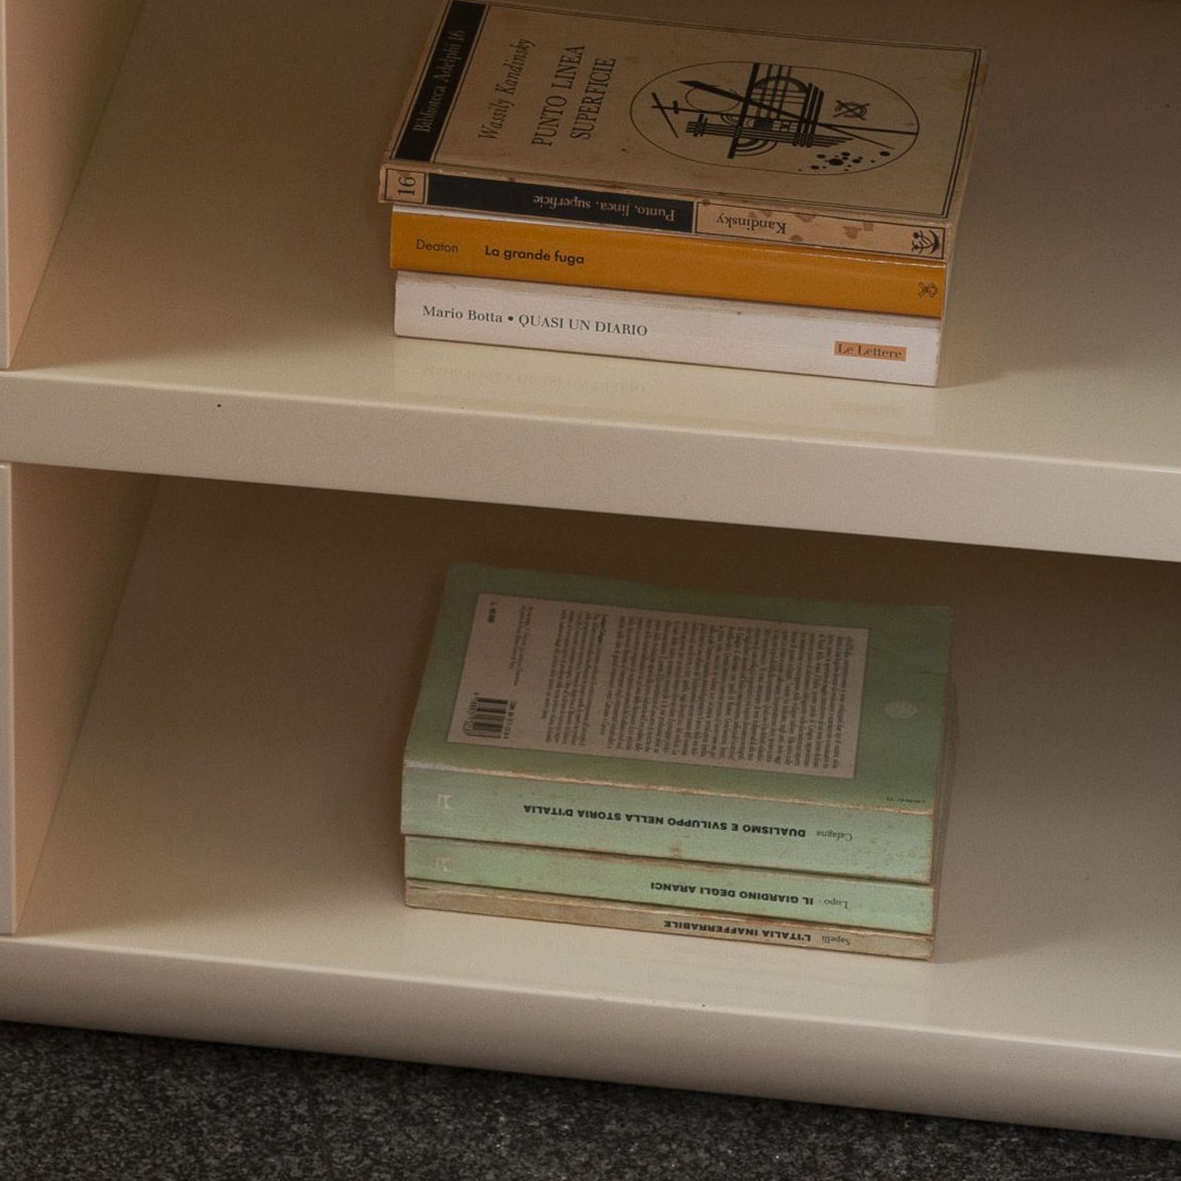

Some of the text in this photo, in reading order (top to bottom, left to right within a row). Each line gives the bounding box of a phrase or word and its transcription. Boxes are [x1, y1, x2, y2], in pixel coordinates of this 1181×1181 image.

[412, 84, 446, 133] Biblioteca
[434, 42, 462, 83] Adelphi
[478, 38, 536, 139] Wassily Kandinsky
[531, 45, 585, 146] PUNTO LINEA
[569, 58, 617, 140] SUPERFICIE
[397, 176, 417, 196] 16
[533, 194, 592, 210] superficie
[634, 204, 675, 222] Punto,
[715, 211, 787, 235] Kandinsky
[415, 239, 585, 267] Deaton La grande fuga
[422, 305, 648, 337] Mario Botta QUASI UN DIARIO
[837, 342, 903, 359] Le Lettere
[523, 804, 853, 842] Cafagna DUALISMO E SVILUPPO NELLA STORIA D'ITALIA
[650, 881, 849, 909] Lupo IL GIARDINO DEGLI ARANCI
[664, 920, 852, 946] Sapelli L'ITALIA INAFFERRABILE
